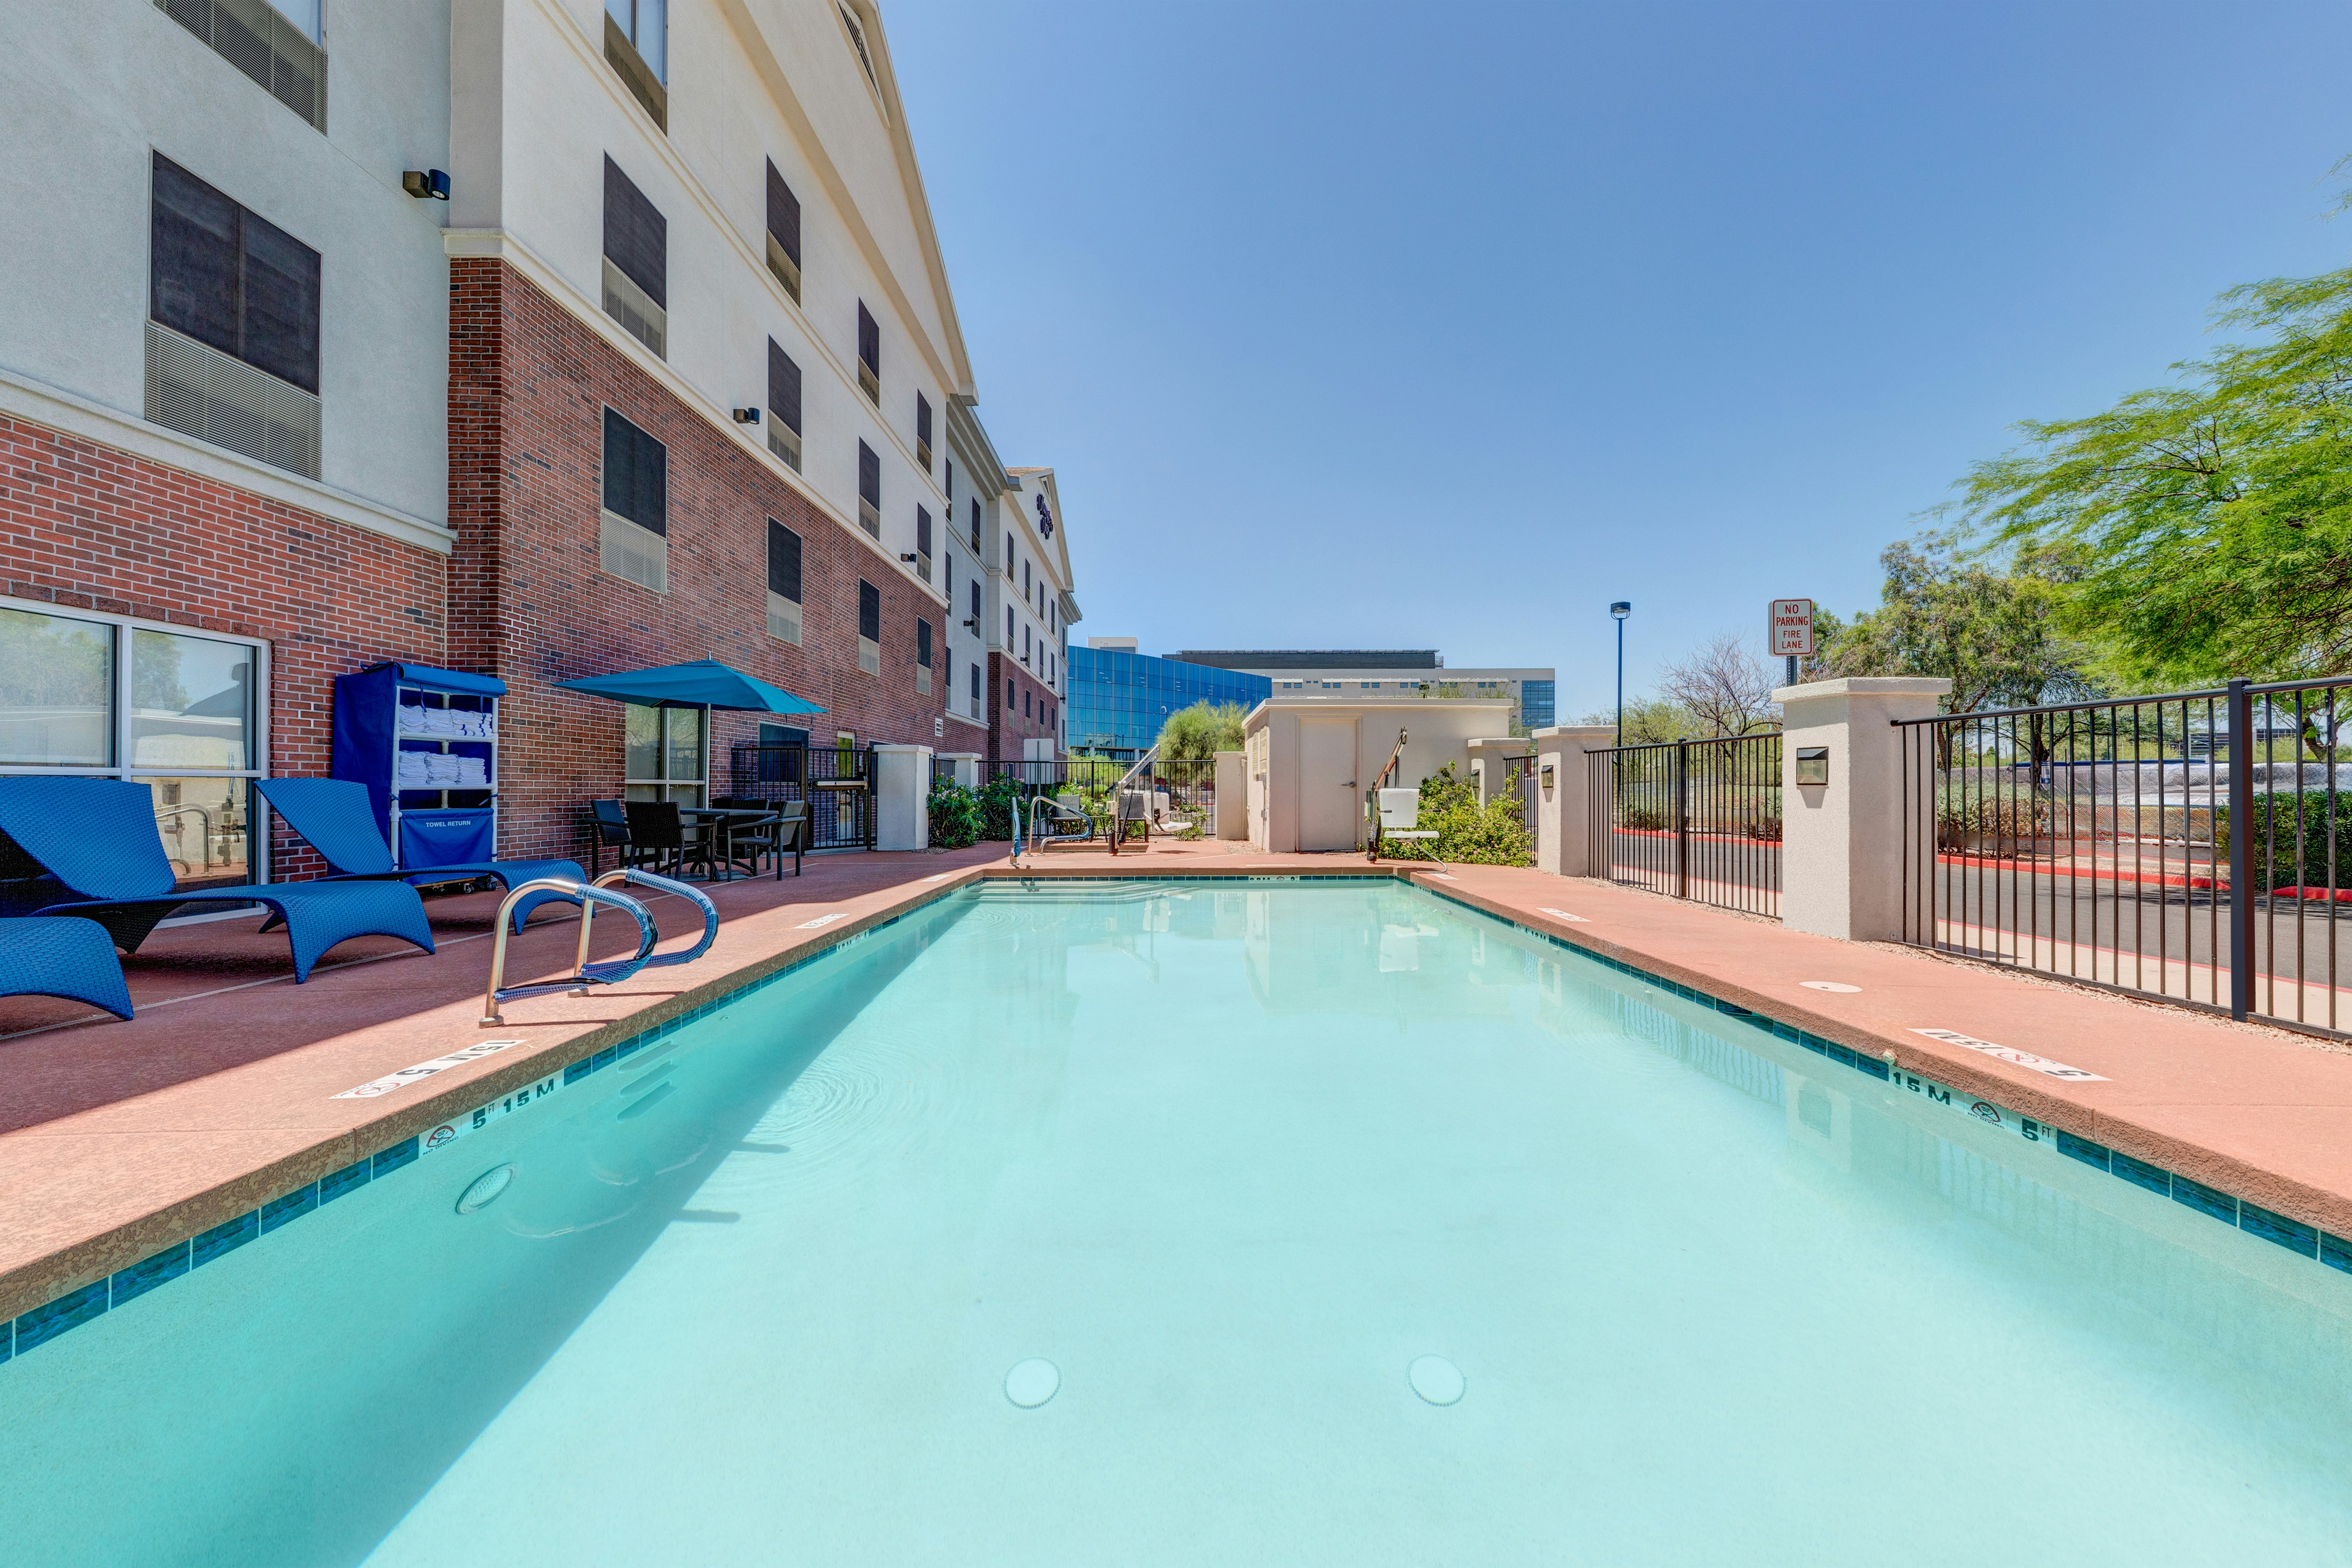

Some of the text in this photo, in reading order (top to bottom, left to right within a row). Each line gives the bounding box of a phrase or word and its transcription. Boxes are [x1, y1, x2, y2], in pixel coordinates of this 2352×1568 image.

[1785, 604, 1799, 614] NO
[1777, 616, 1808, 626] PARKING
[472, 1108, 487, 1129] 5
[488, 1103, 495, 1114] FT
[1980, 1117, 2005, 1129] DIVING
[2022, 1118, 2051, 1142] 5 FT
[435, 1136, 459, 1149] DIVING
